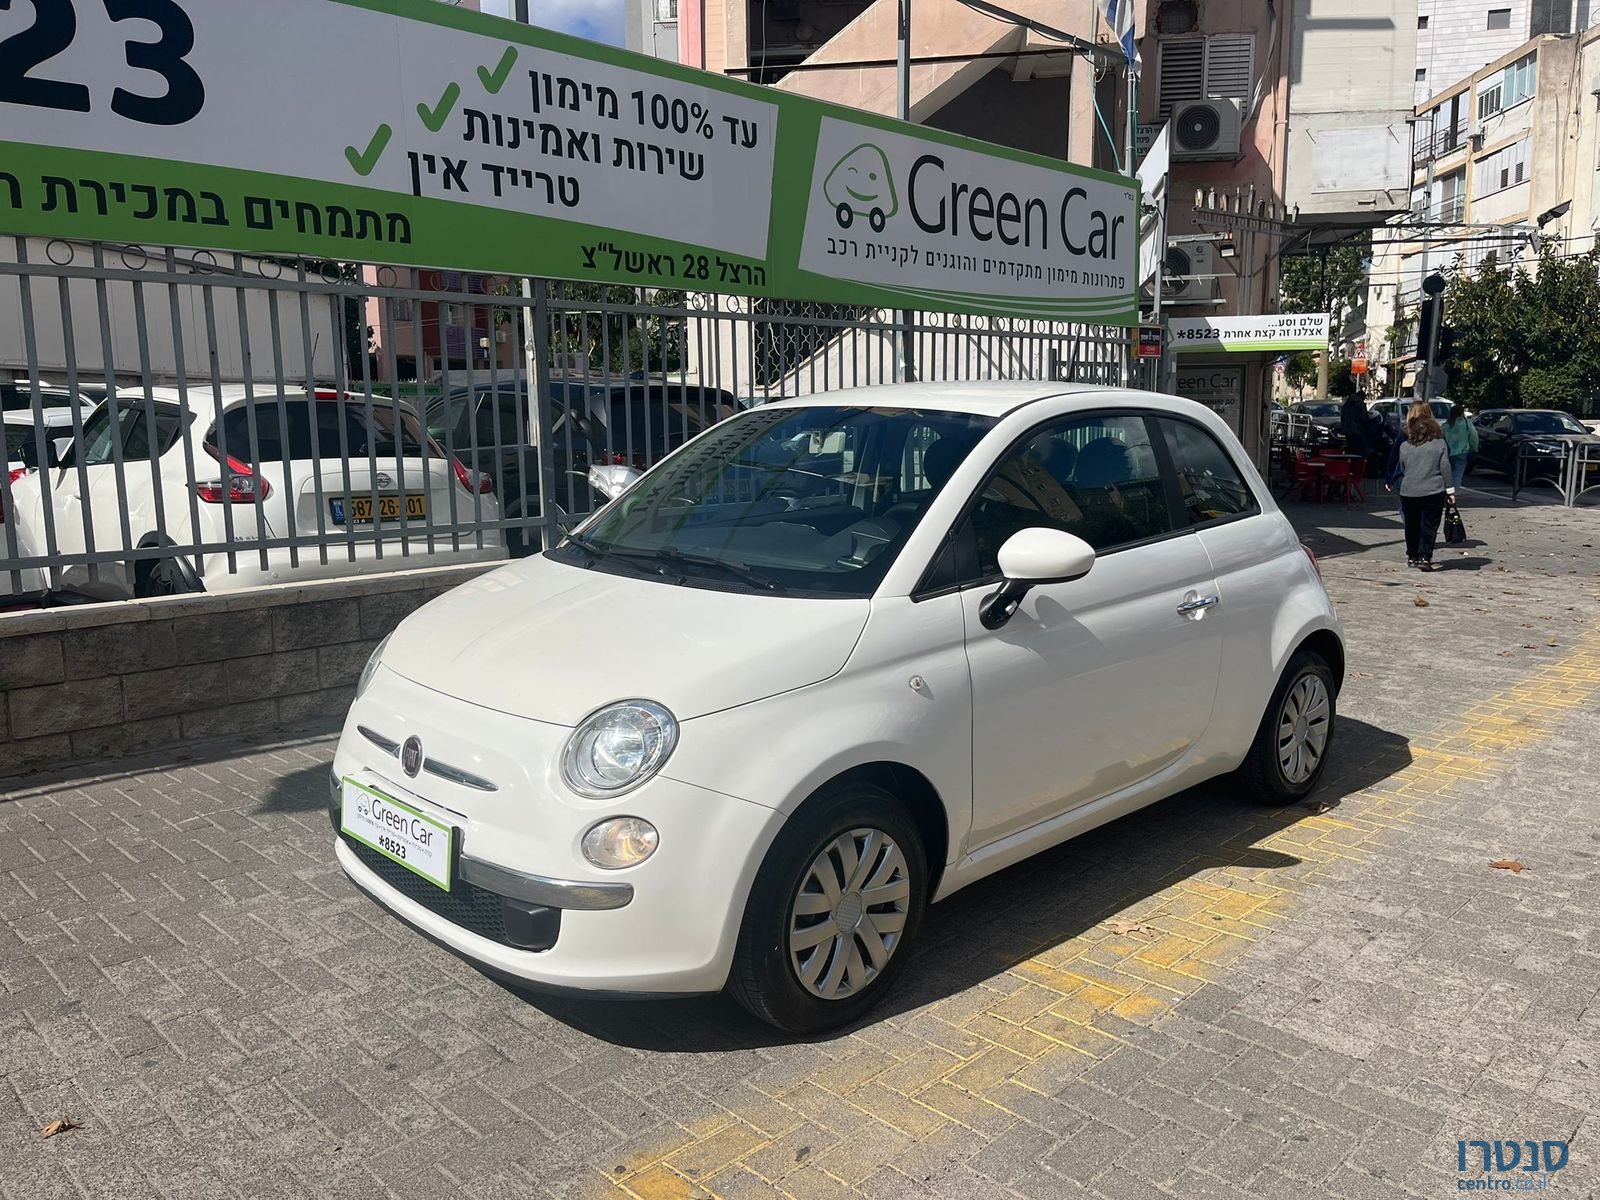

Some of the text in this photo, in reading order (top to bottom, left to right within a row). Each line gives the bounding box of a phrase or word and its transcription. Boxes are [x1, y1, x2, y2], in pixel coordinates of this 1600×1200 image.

[528, 70, 758, 149] עד 100% מימון
[462, 107, 705, 181] שירות ואמינות
[407, 150, 580, 208] טרייד אין
[40, 175, 230, 227] במכירת
[243, 196, 412, 245] מתמחים
[907, 154, 1125, 260] Green Car
[682, 253, 709, 281] 28
[715, 255, 766, 287] הרצל
[827, 237, 1125, 290] פתרונות מימון מתקדמים והוגנים לקניית רכב
[1223, 330, 1251, 339] אחרת
[1254, 328, 1276, 340] קצת
[1278, 328, 1291, 337] זה
[1293, 326, 1323, 337] אצלנו
[1300, 316, 1323, 327] שלם
[1210, 374, 1236, 388] Car
[372, 799, 408, 835] Green
[411, 819, 433, 847] Car
